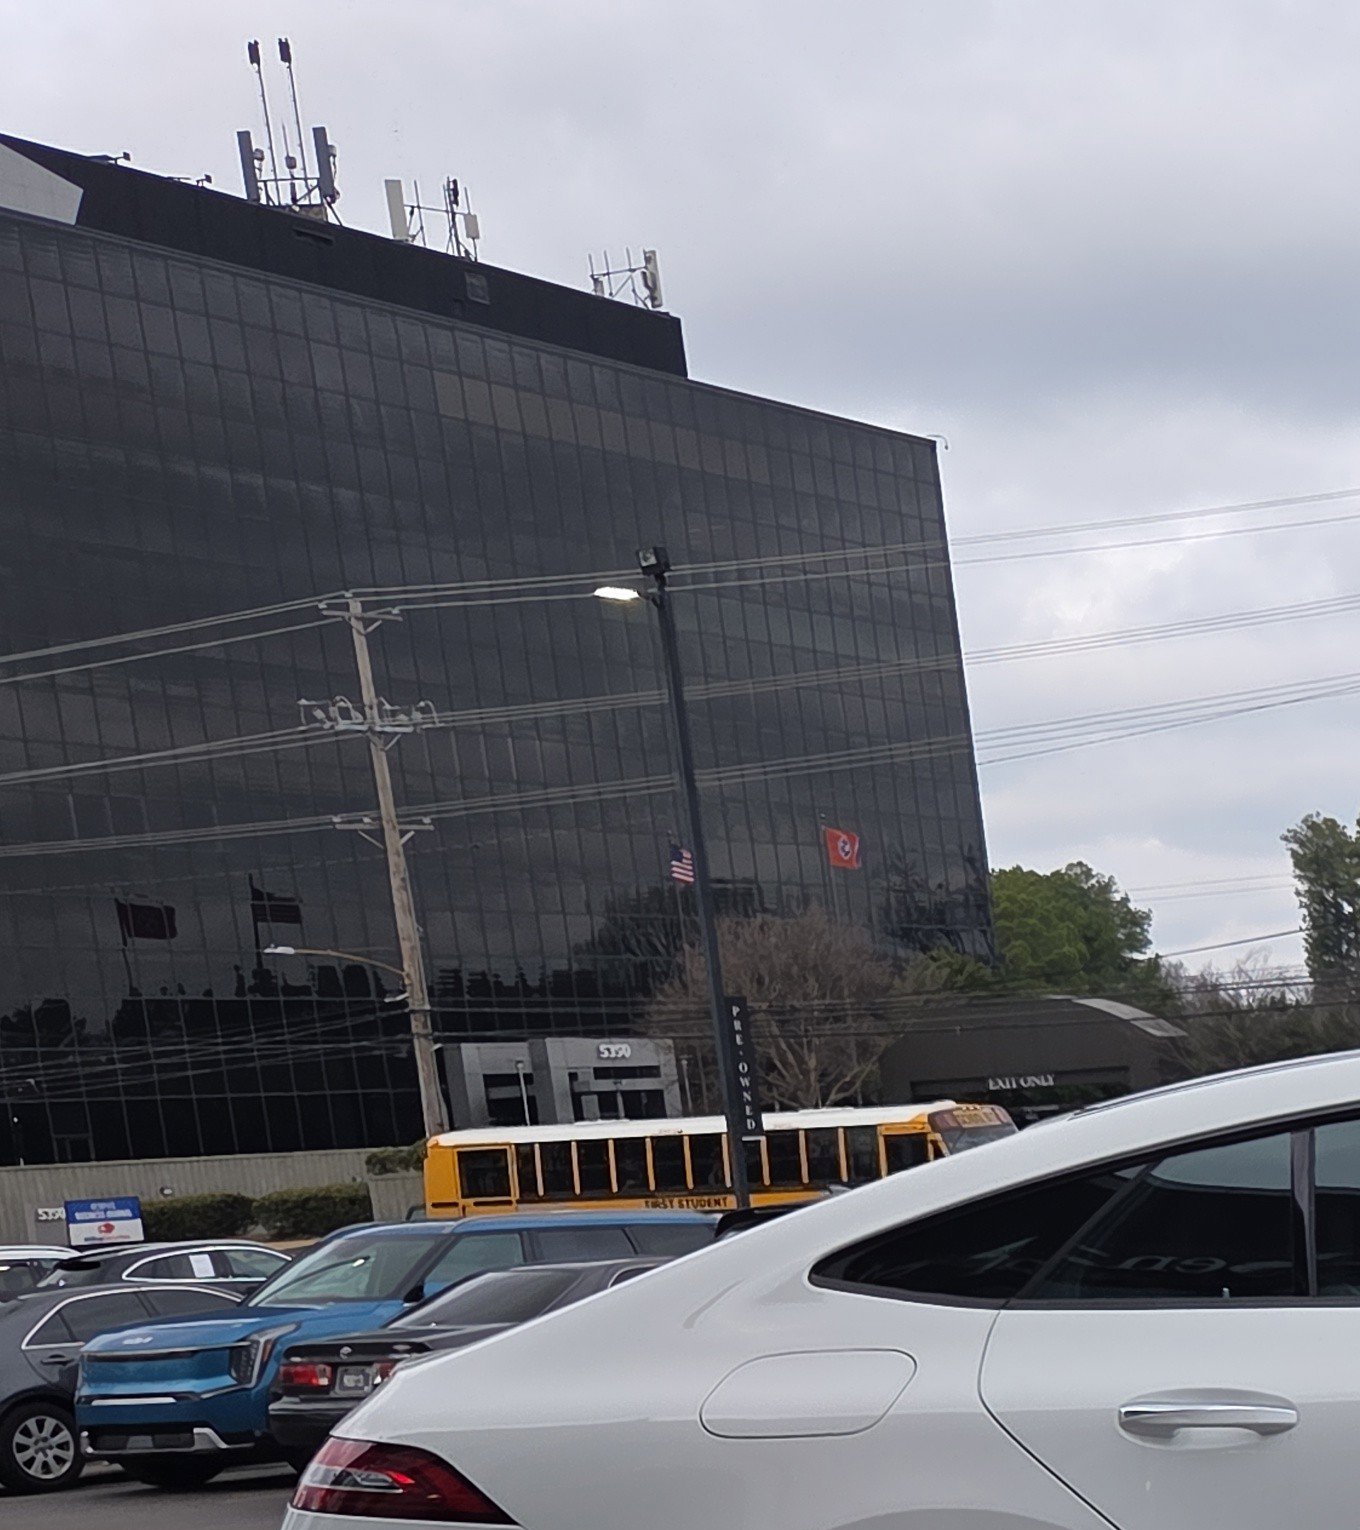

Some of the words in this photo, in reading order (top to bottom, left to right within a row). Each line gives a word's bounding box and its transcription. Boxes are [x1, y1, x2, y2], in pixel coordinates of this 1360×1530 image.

[988, 1077, 1017, 1091] EXIT
[1019, 1074, 1055, 1088] ONLY
[677, 1196, 728, 1209] STUDENT
